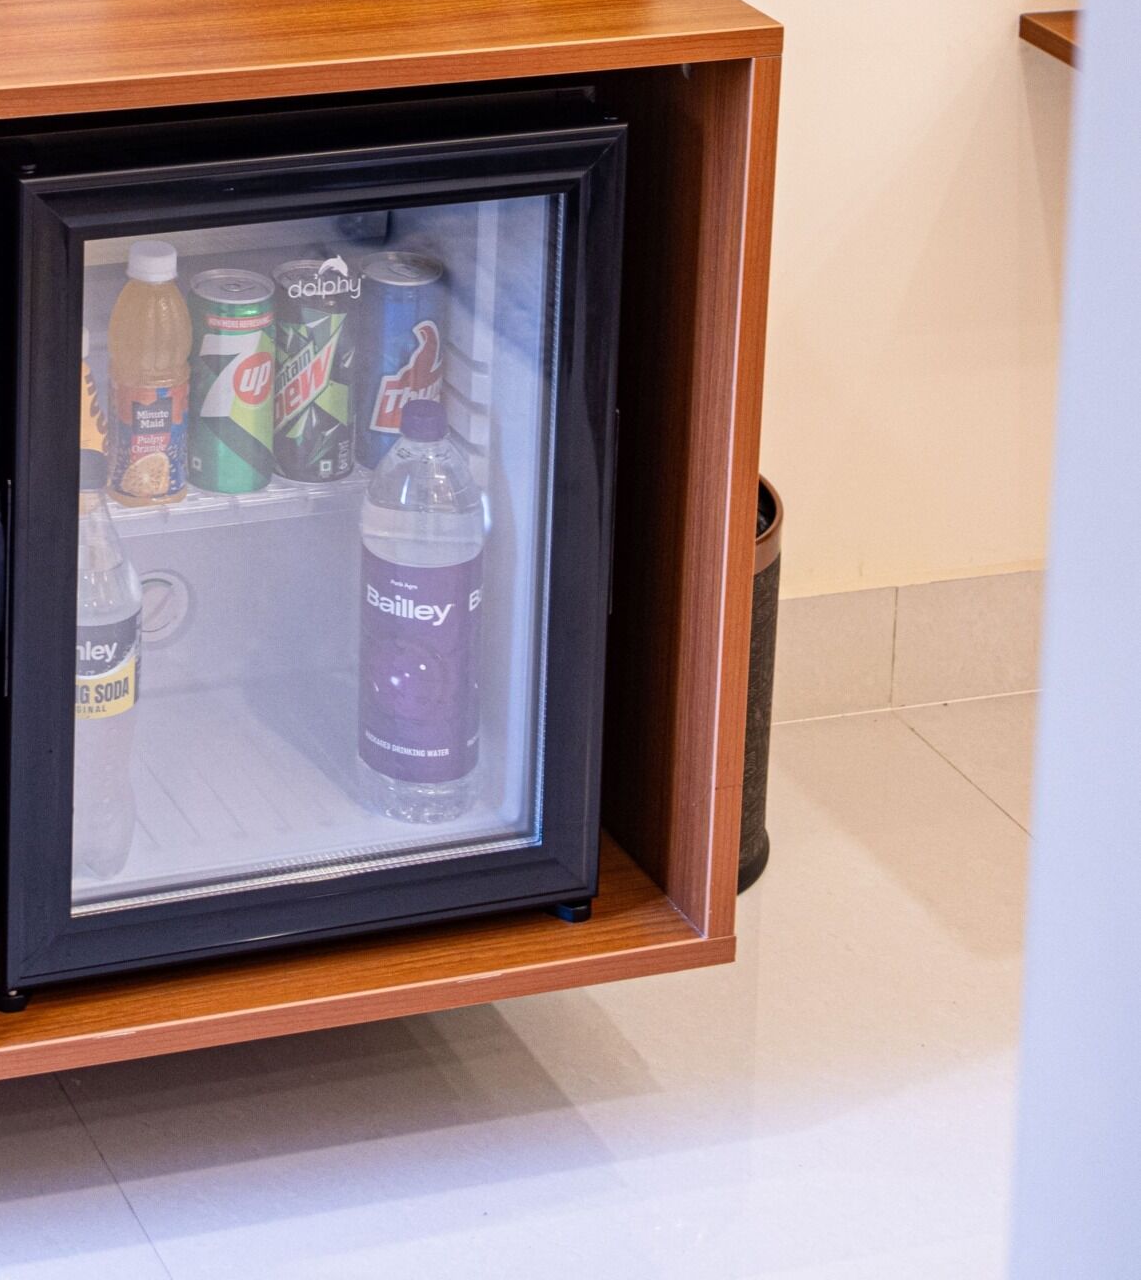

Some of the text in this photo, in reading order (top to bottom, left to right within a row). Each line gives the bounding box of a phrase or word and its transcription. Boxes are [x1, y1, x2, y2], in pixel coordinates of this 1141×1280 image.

[288, 275, 361, 299] dolphy
[137, 410, 169, 419] Minute
[140, 419, 164, 428] Maid
[367, 584, 452, 626] Bailley
[76, 641, 117, 663] nley
[95, 676, 129, 704] SODA
[392, 744, 425, 757] DRINKING
[427, 748, 449, 757] WATER
